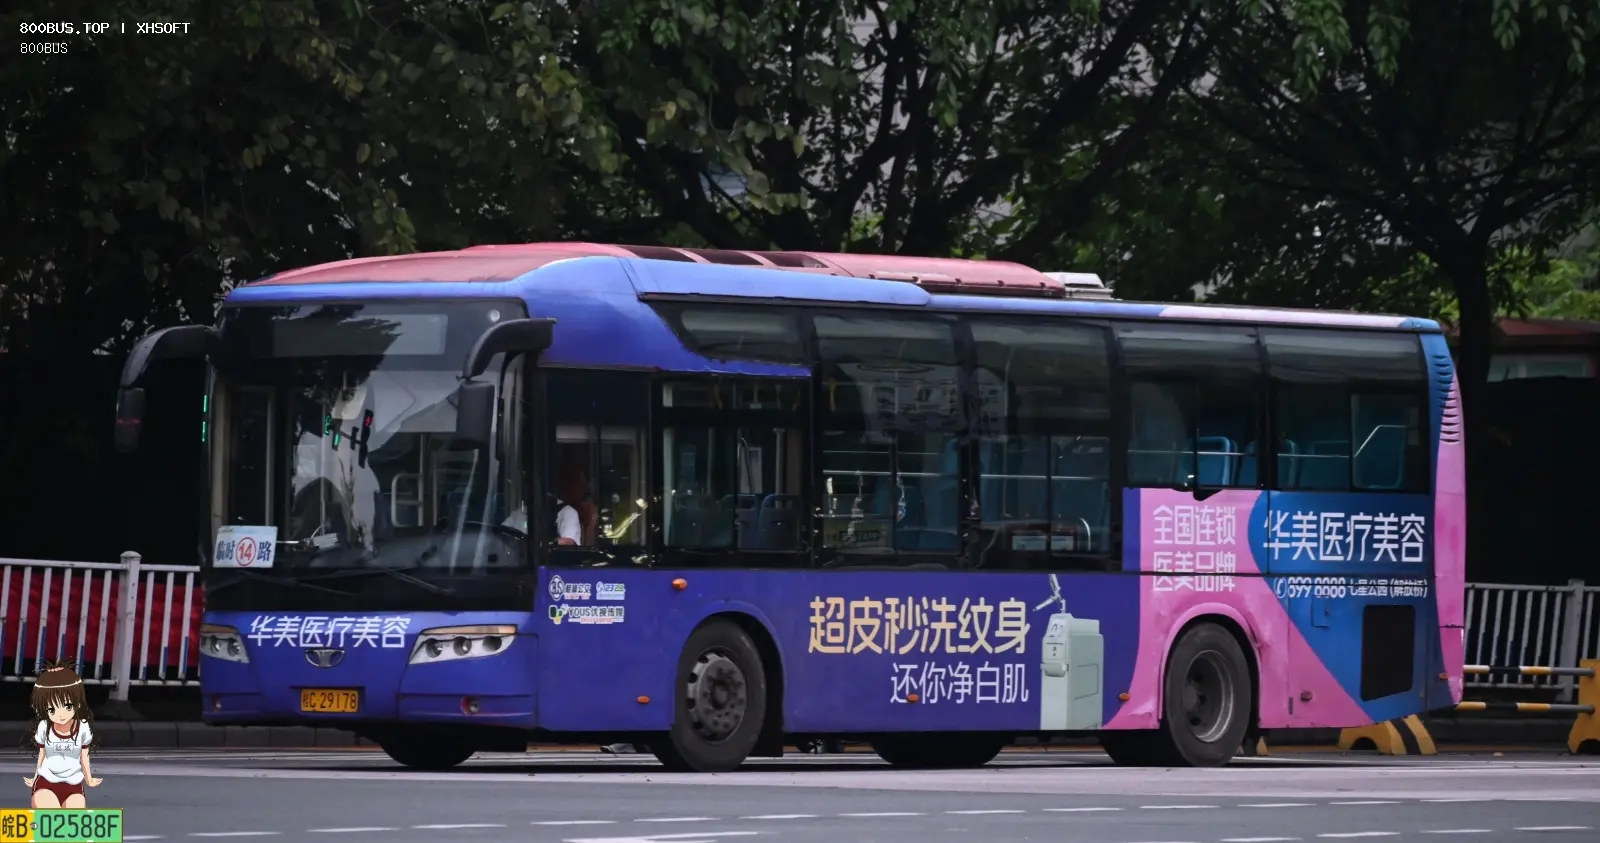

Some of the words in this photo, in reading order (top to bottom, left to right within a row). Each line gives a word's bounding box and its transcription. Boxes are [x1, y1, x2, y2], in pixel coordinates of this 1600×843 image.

[1152, 504, 1236, 546] 全国连锁
[1263, 509, 1426, 563] 华美医疗美容
[1153, 550, 1236, 593] 医美品牌
[247, 614, 411, 648] 华美医疗美容
[808, 596, 1031, 655] 超皮秒洗纹身
[890, 660, 1030, 705] 还你净白肌
